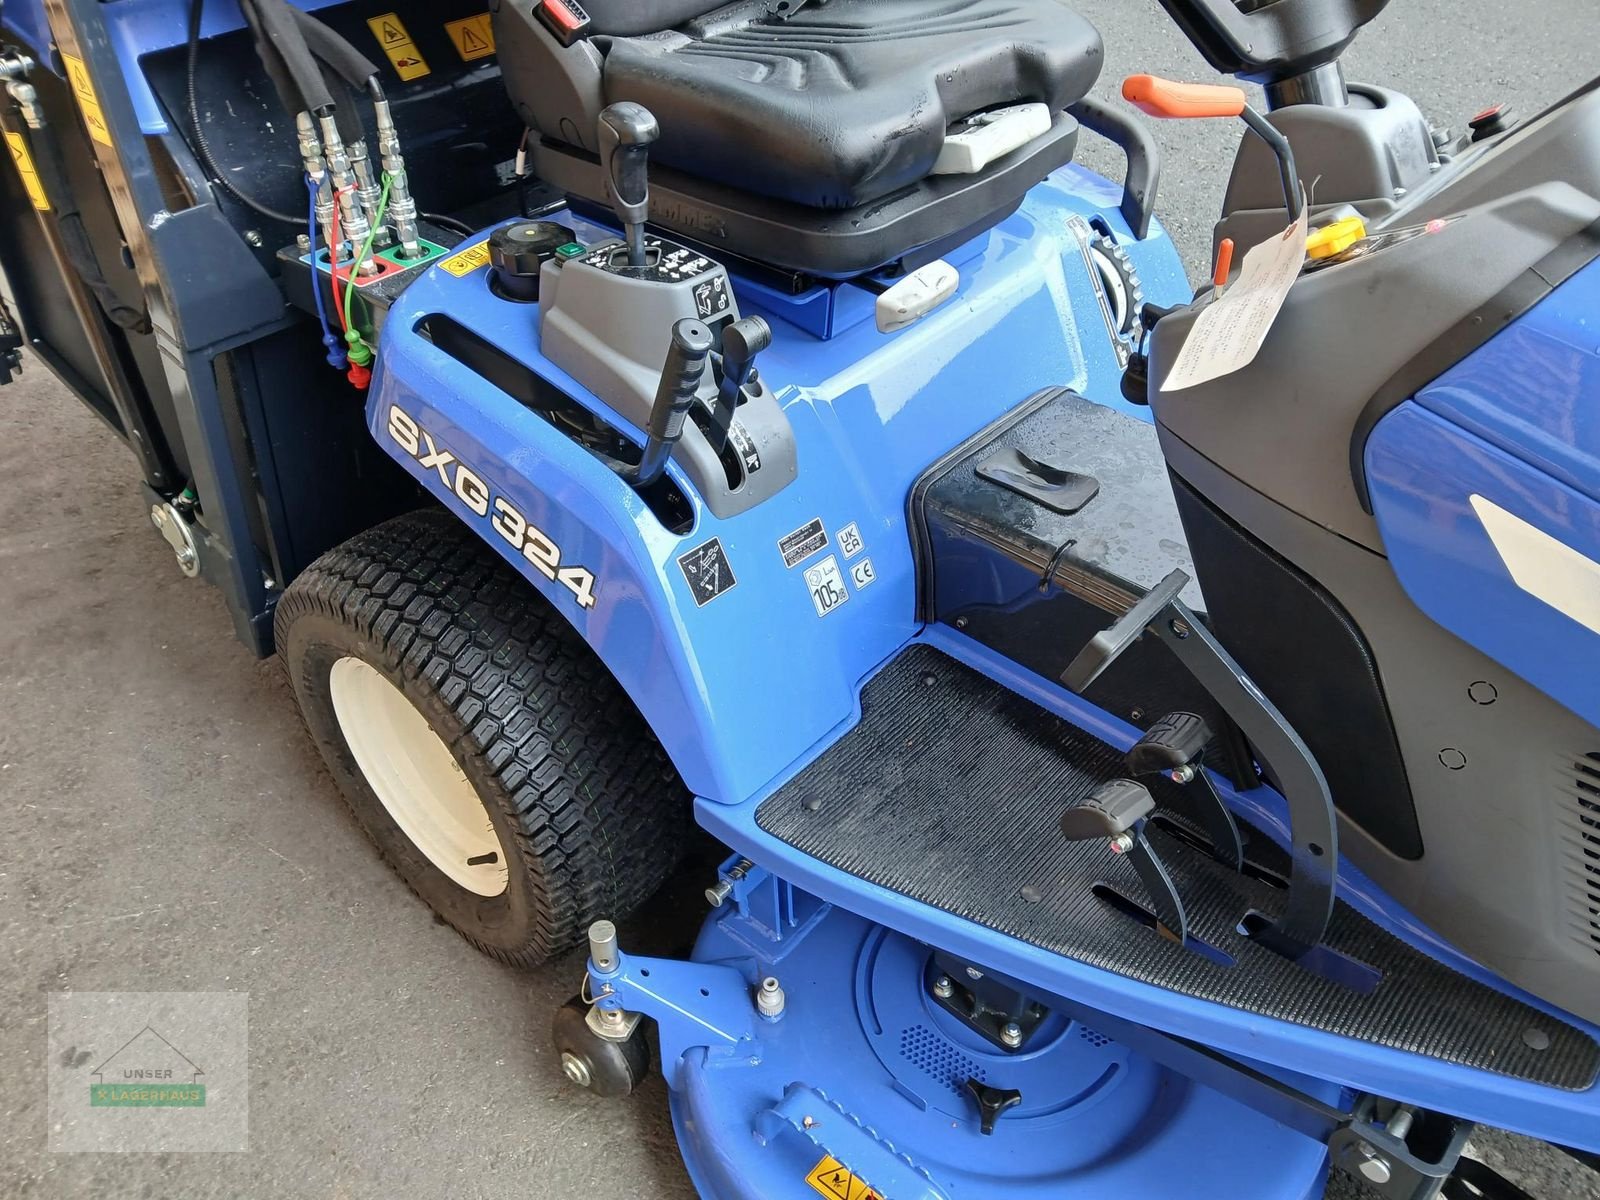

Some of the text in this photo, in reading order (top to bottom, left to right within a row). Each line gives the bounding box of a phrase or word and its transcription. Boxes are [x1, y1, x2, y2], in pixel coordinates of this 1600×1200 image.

[388, 404, 598, 610] SXG 324
[840, 527, 856, 543] UK
[844, 538, 860, 553] CA
[855, 562, 872, 583] CE
[814, 579, 839, 610] 105
